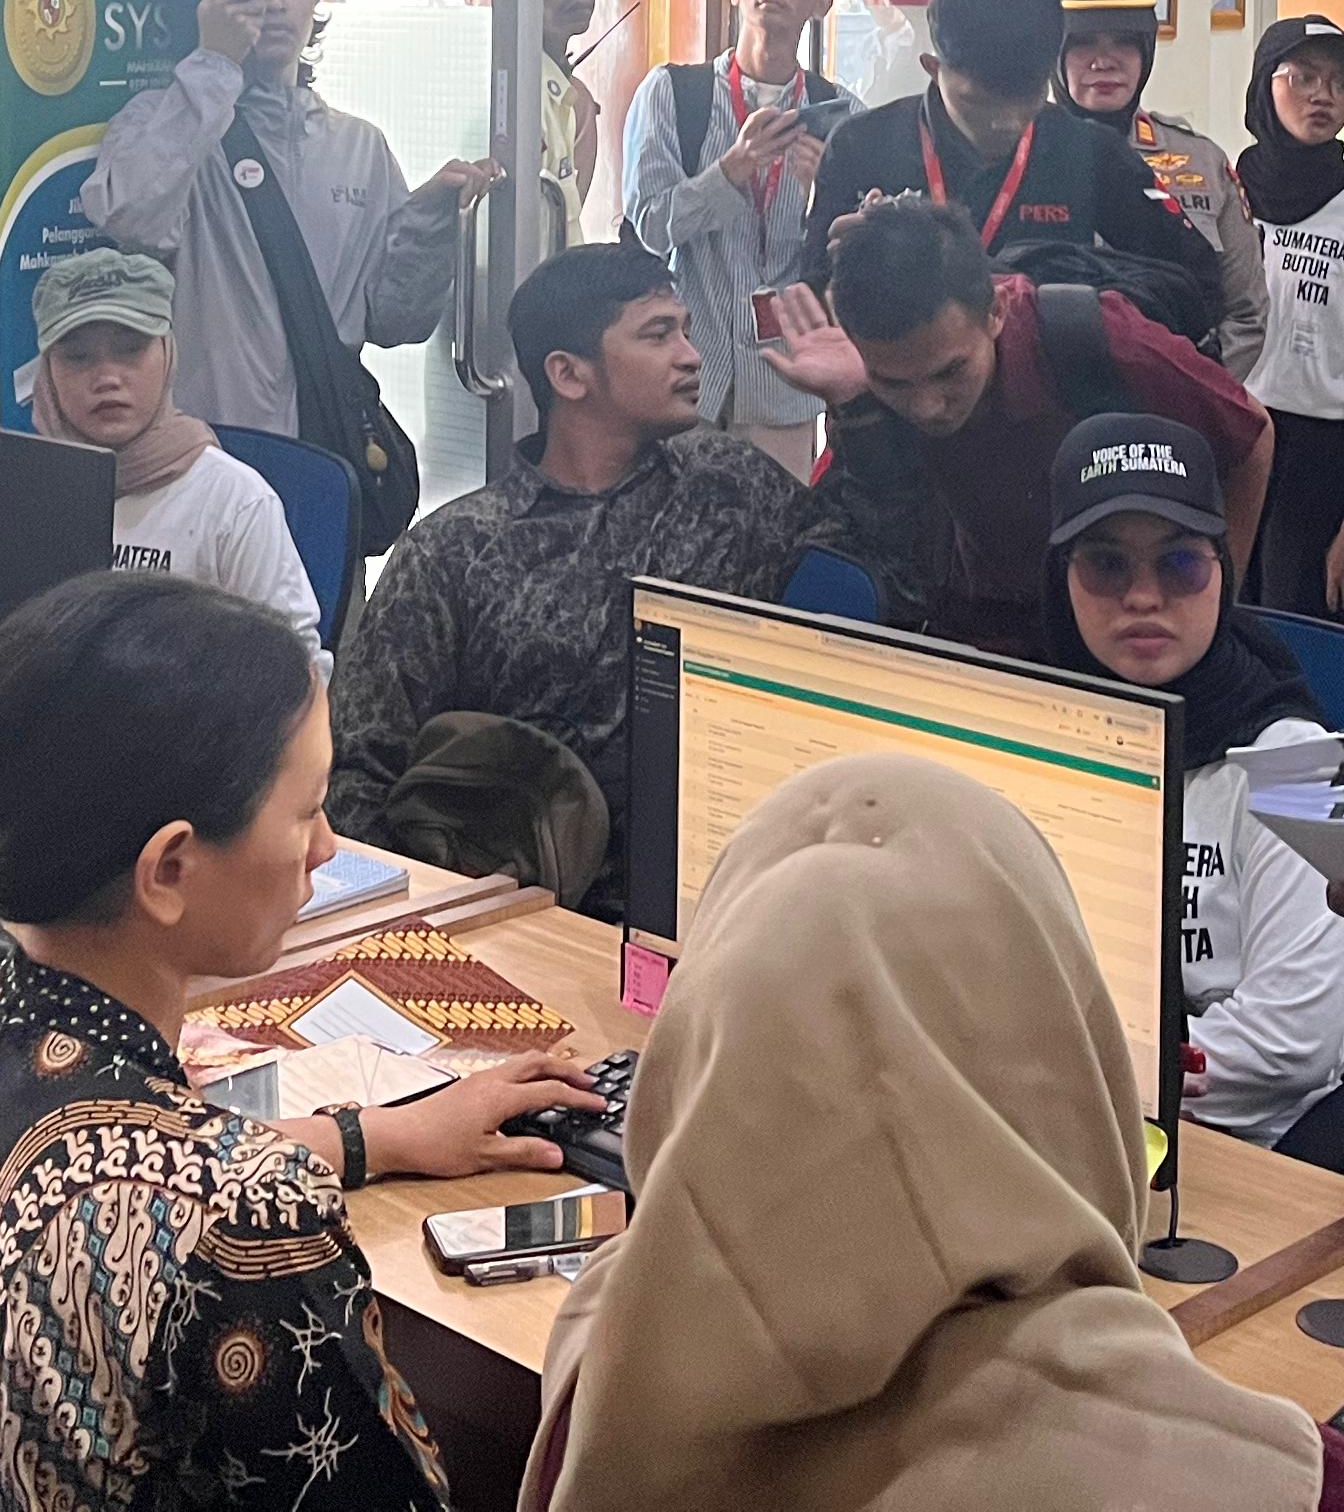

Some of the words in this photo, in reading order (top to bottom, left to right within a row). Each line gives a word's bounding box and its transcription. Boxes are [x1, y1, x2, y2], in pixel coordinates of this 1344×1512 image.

[1019, 204, 1070, 223] PERS
[1181, 194, 1210, 211] LRI
[1281, 253, 1330, 280] BUTUH
[1296, 279, 1329, 306] KITA
[1093, 445, 1127, 464] VOICE
[1128, 443, 1146, 459] OF
[1148, 444, 1173, 460] THE
[1081, 459, 1117, 483] EARTH
[1121, 457, 1187, 477] SUMATERA
[1182, 928, 1214, 963] TA
